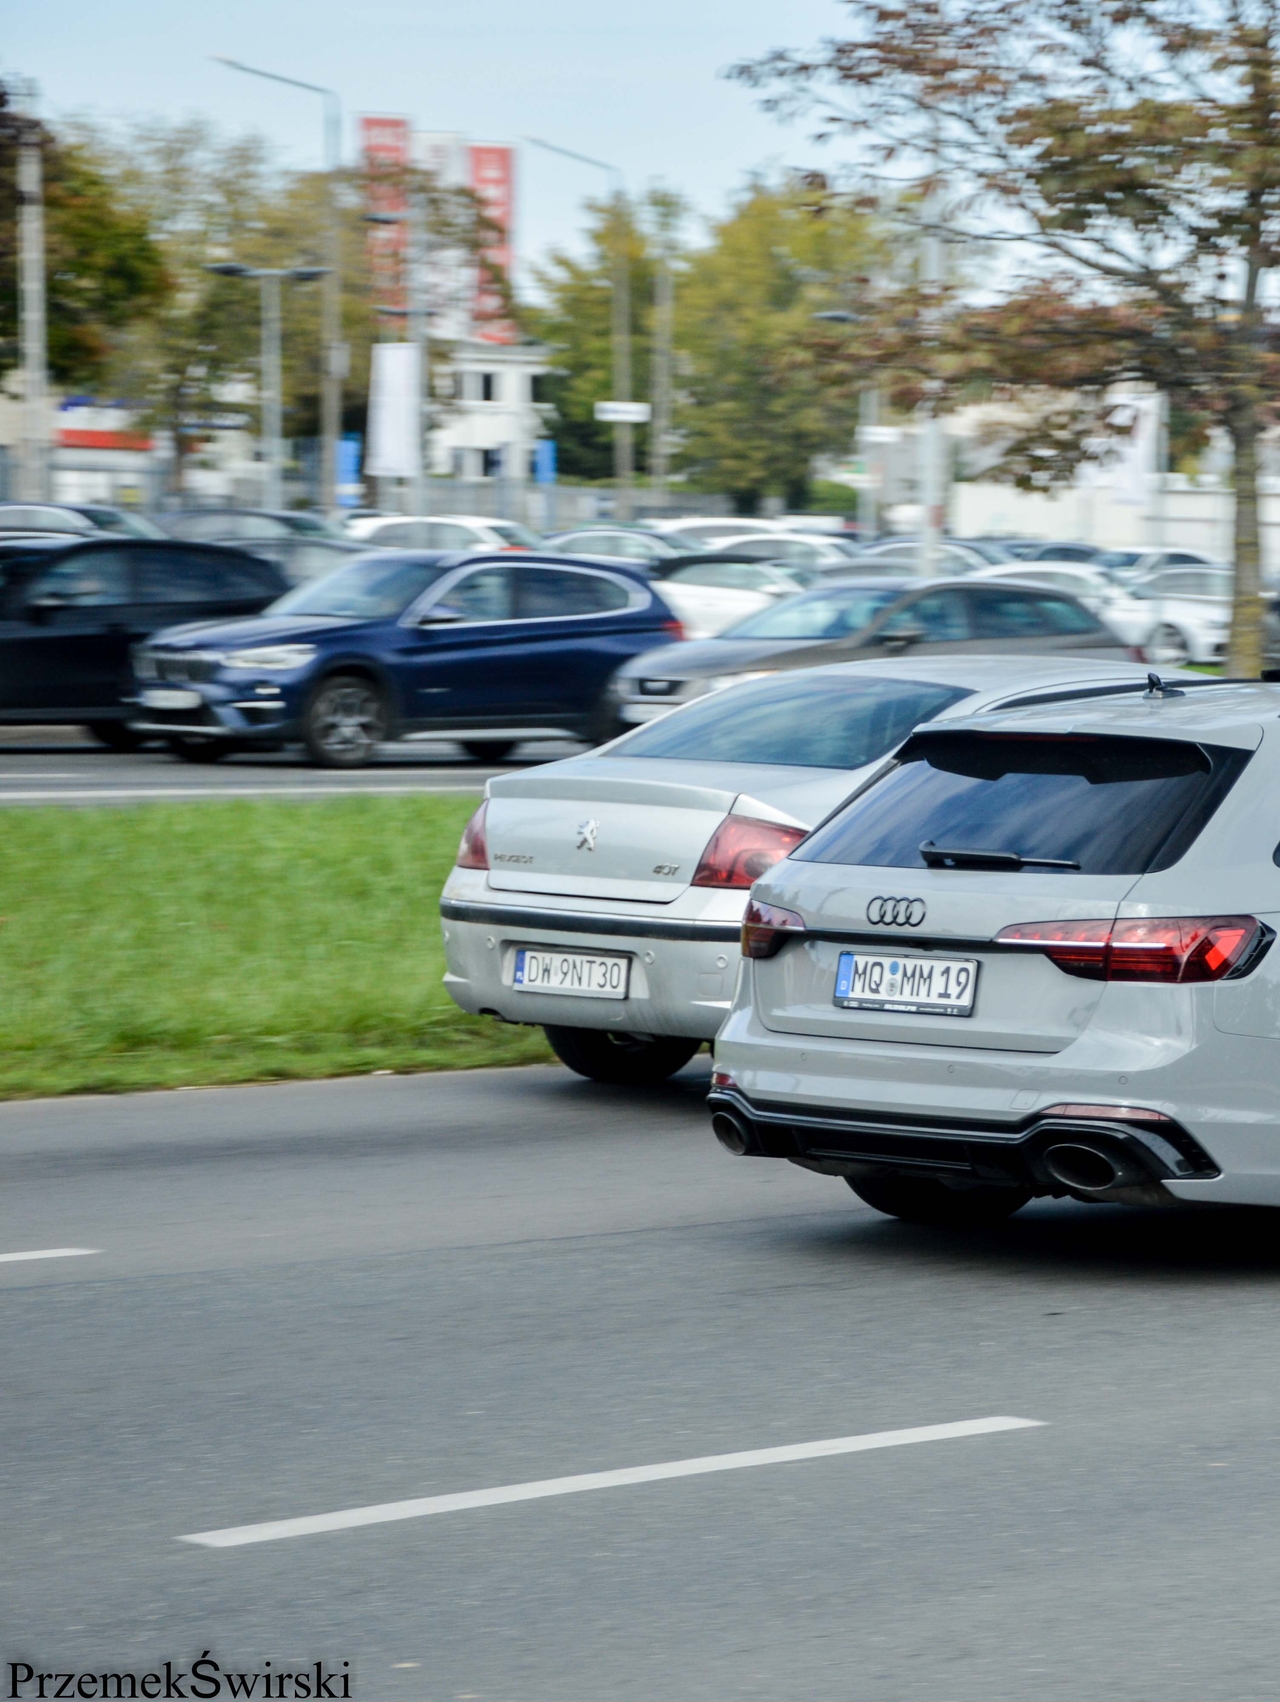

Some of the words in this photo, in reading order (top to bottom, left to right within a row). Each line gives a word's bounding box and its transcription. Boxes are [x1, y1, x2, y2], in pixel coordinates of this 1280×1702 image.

[652, 863, 681, 877] 407
[527, 955, 553, 984] DW
[558, 957, 622, 990] 9NT30
[851, 959, 885, 994] MQ
[899, 963, 934, 997] MM
[937, 966, 970, 999] 19
